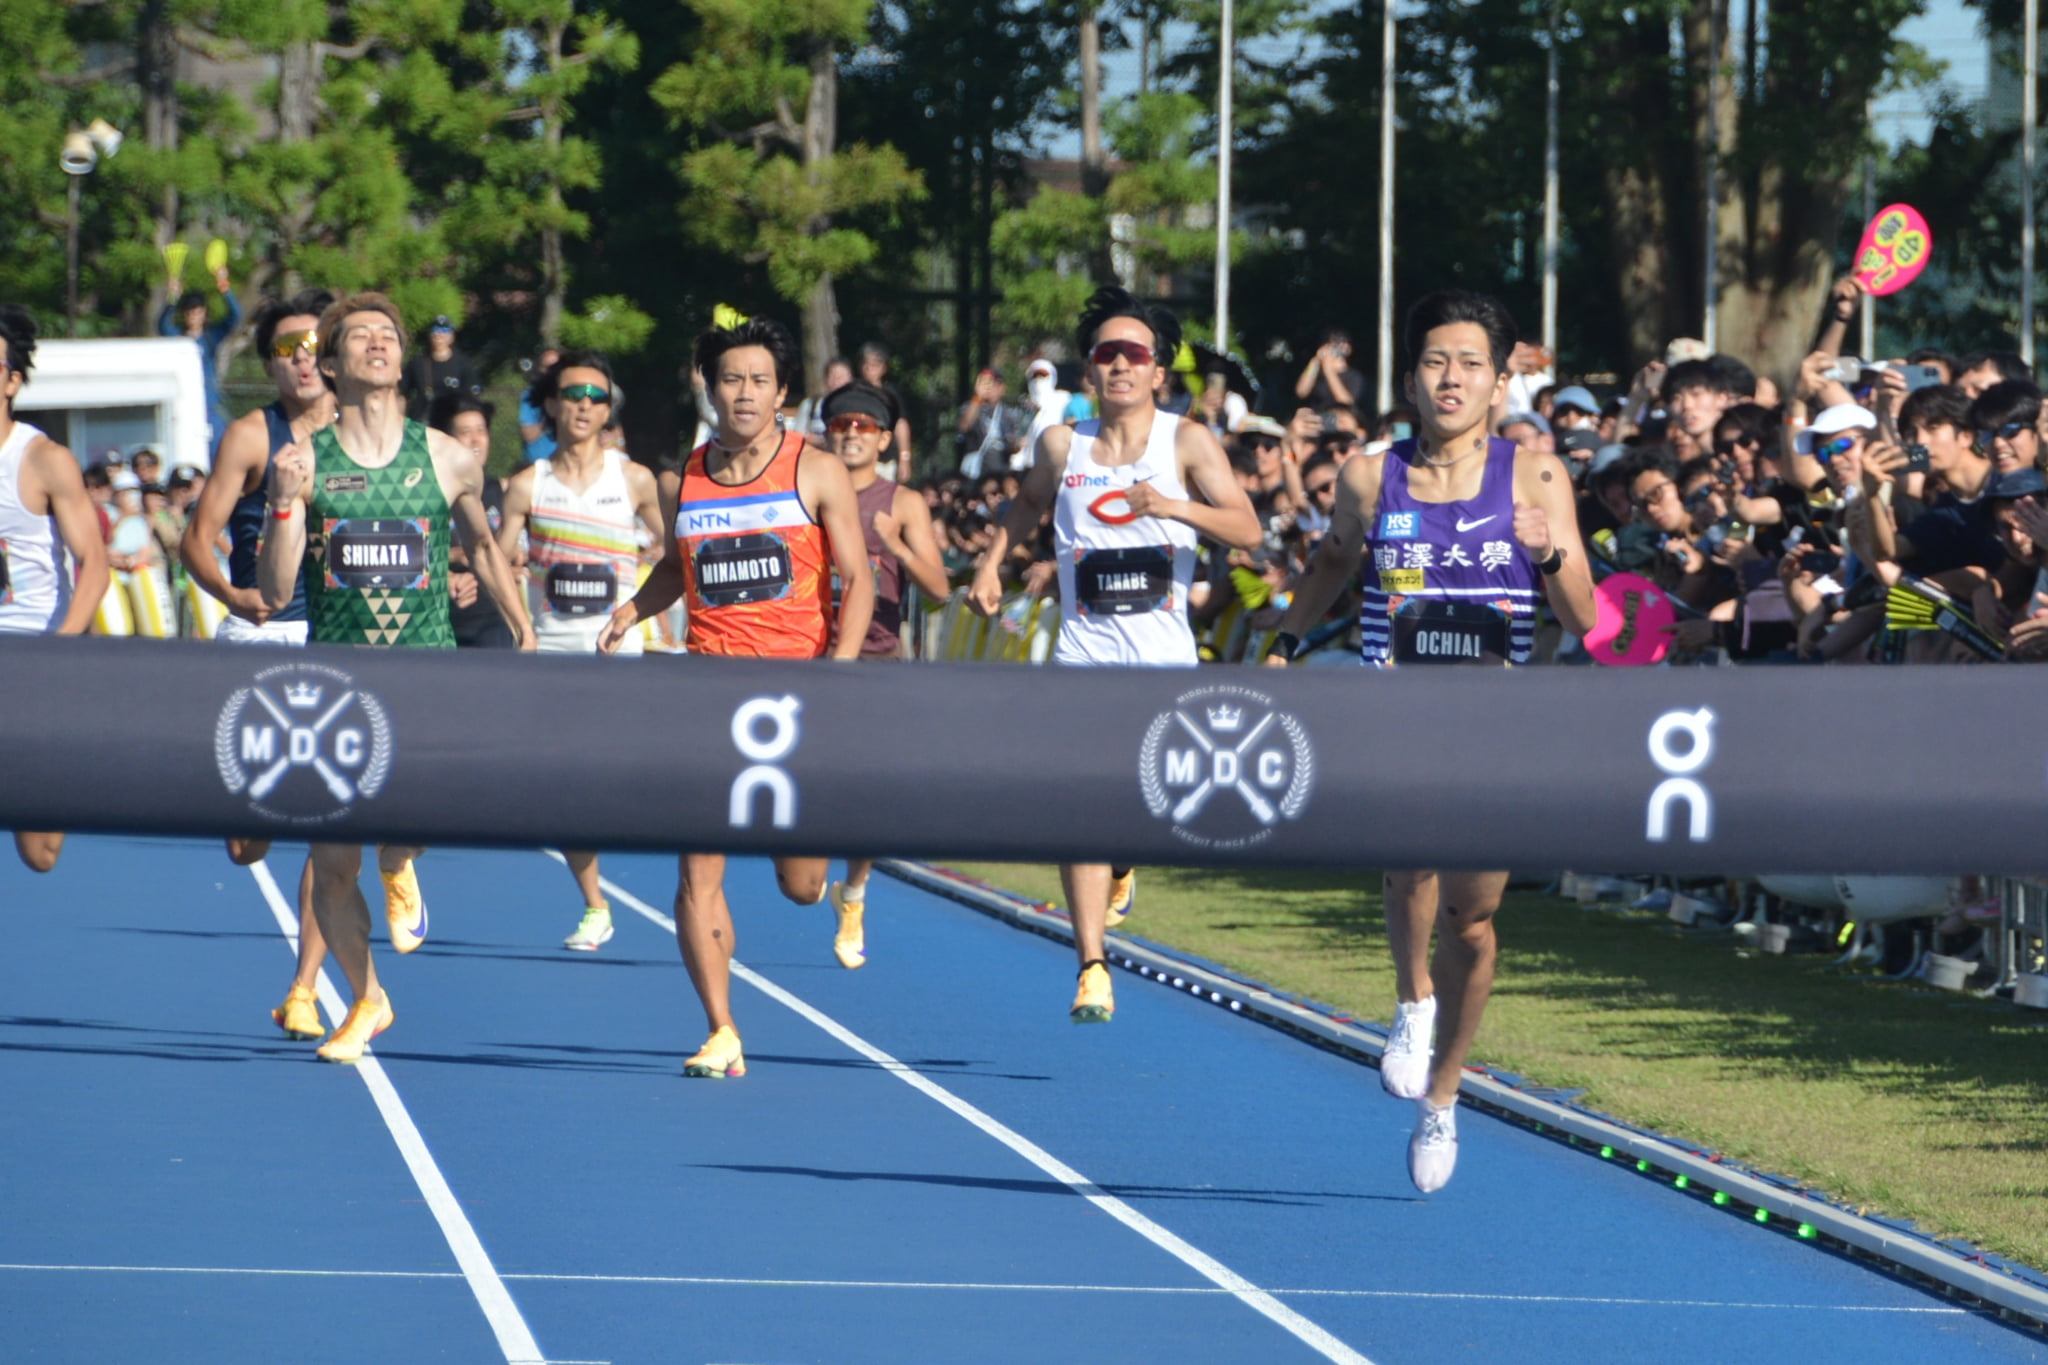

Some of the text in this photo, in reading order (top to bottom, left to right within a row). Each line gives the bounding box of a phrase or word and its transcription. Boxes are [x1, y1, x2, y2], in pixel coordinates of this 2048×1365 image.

[689, 512, 731, 530] NTN
[342, 544, 409, 566] SHIKATA
[702, 556, 781, 585] MINAMOTO
[1096, 571, 1148, 592] TANABE
[1416, 630, 1481, 657] OCHIAI
[254, 663, 353, 683] MIDDLE DISTANCE
[1176, 685, 1273, 704] MIDDLE DISTANCE
[1171, 825, 1211, 847] CIRCUIT
